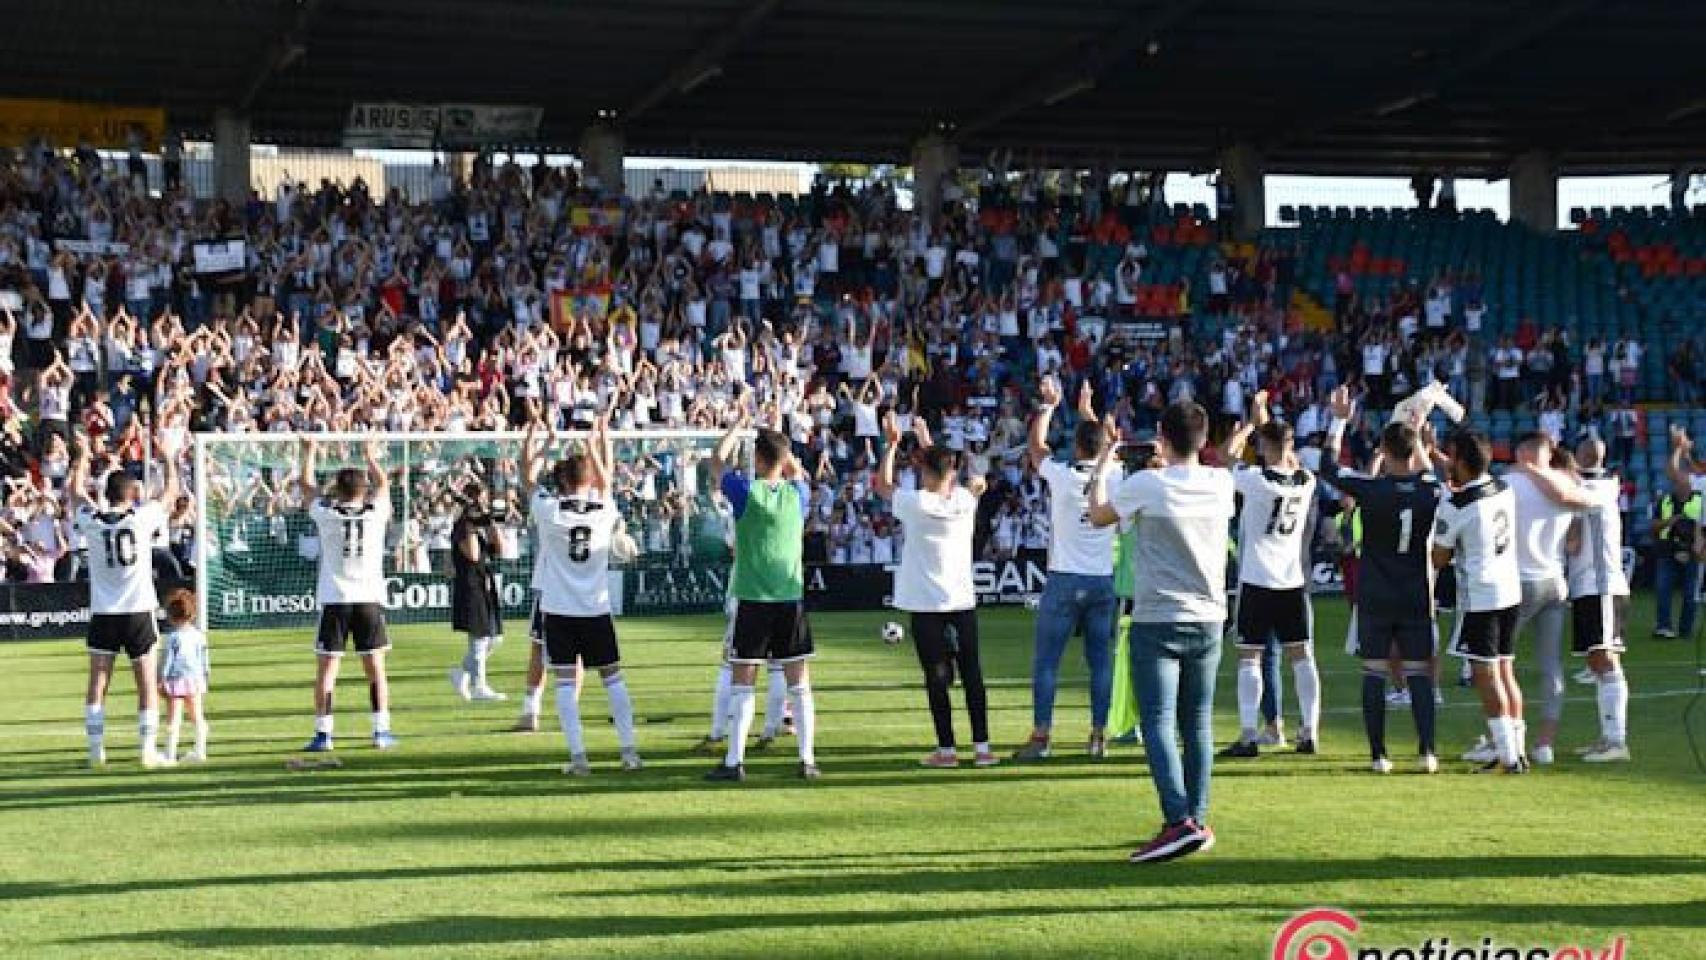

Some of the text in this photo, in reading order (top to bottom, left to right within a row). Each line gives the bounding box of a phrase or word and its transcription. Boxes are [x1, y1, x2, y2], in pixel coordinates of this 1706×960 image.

[1264, 496, 1302, 534] 15
[1397, 508, 1413, 554] 1
[102, 528, 137, 568] 10
[342, 521, 364, 557] 11
[568, 527, 592, 562] 8
[252, 589, 320, 613] mesó
